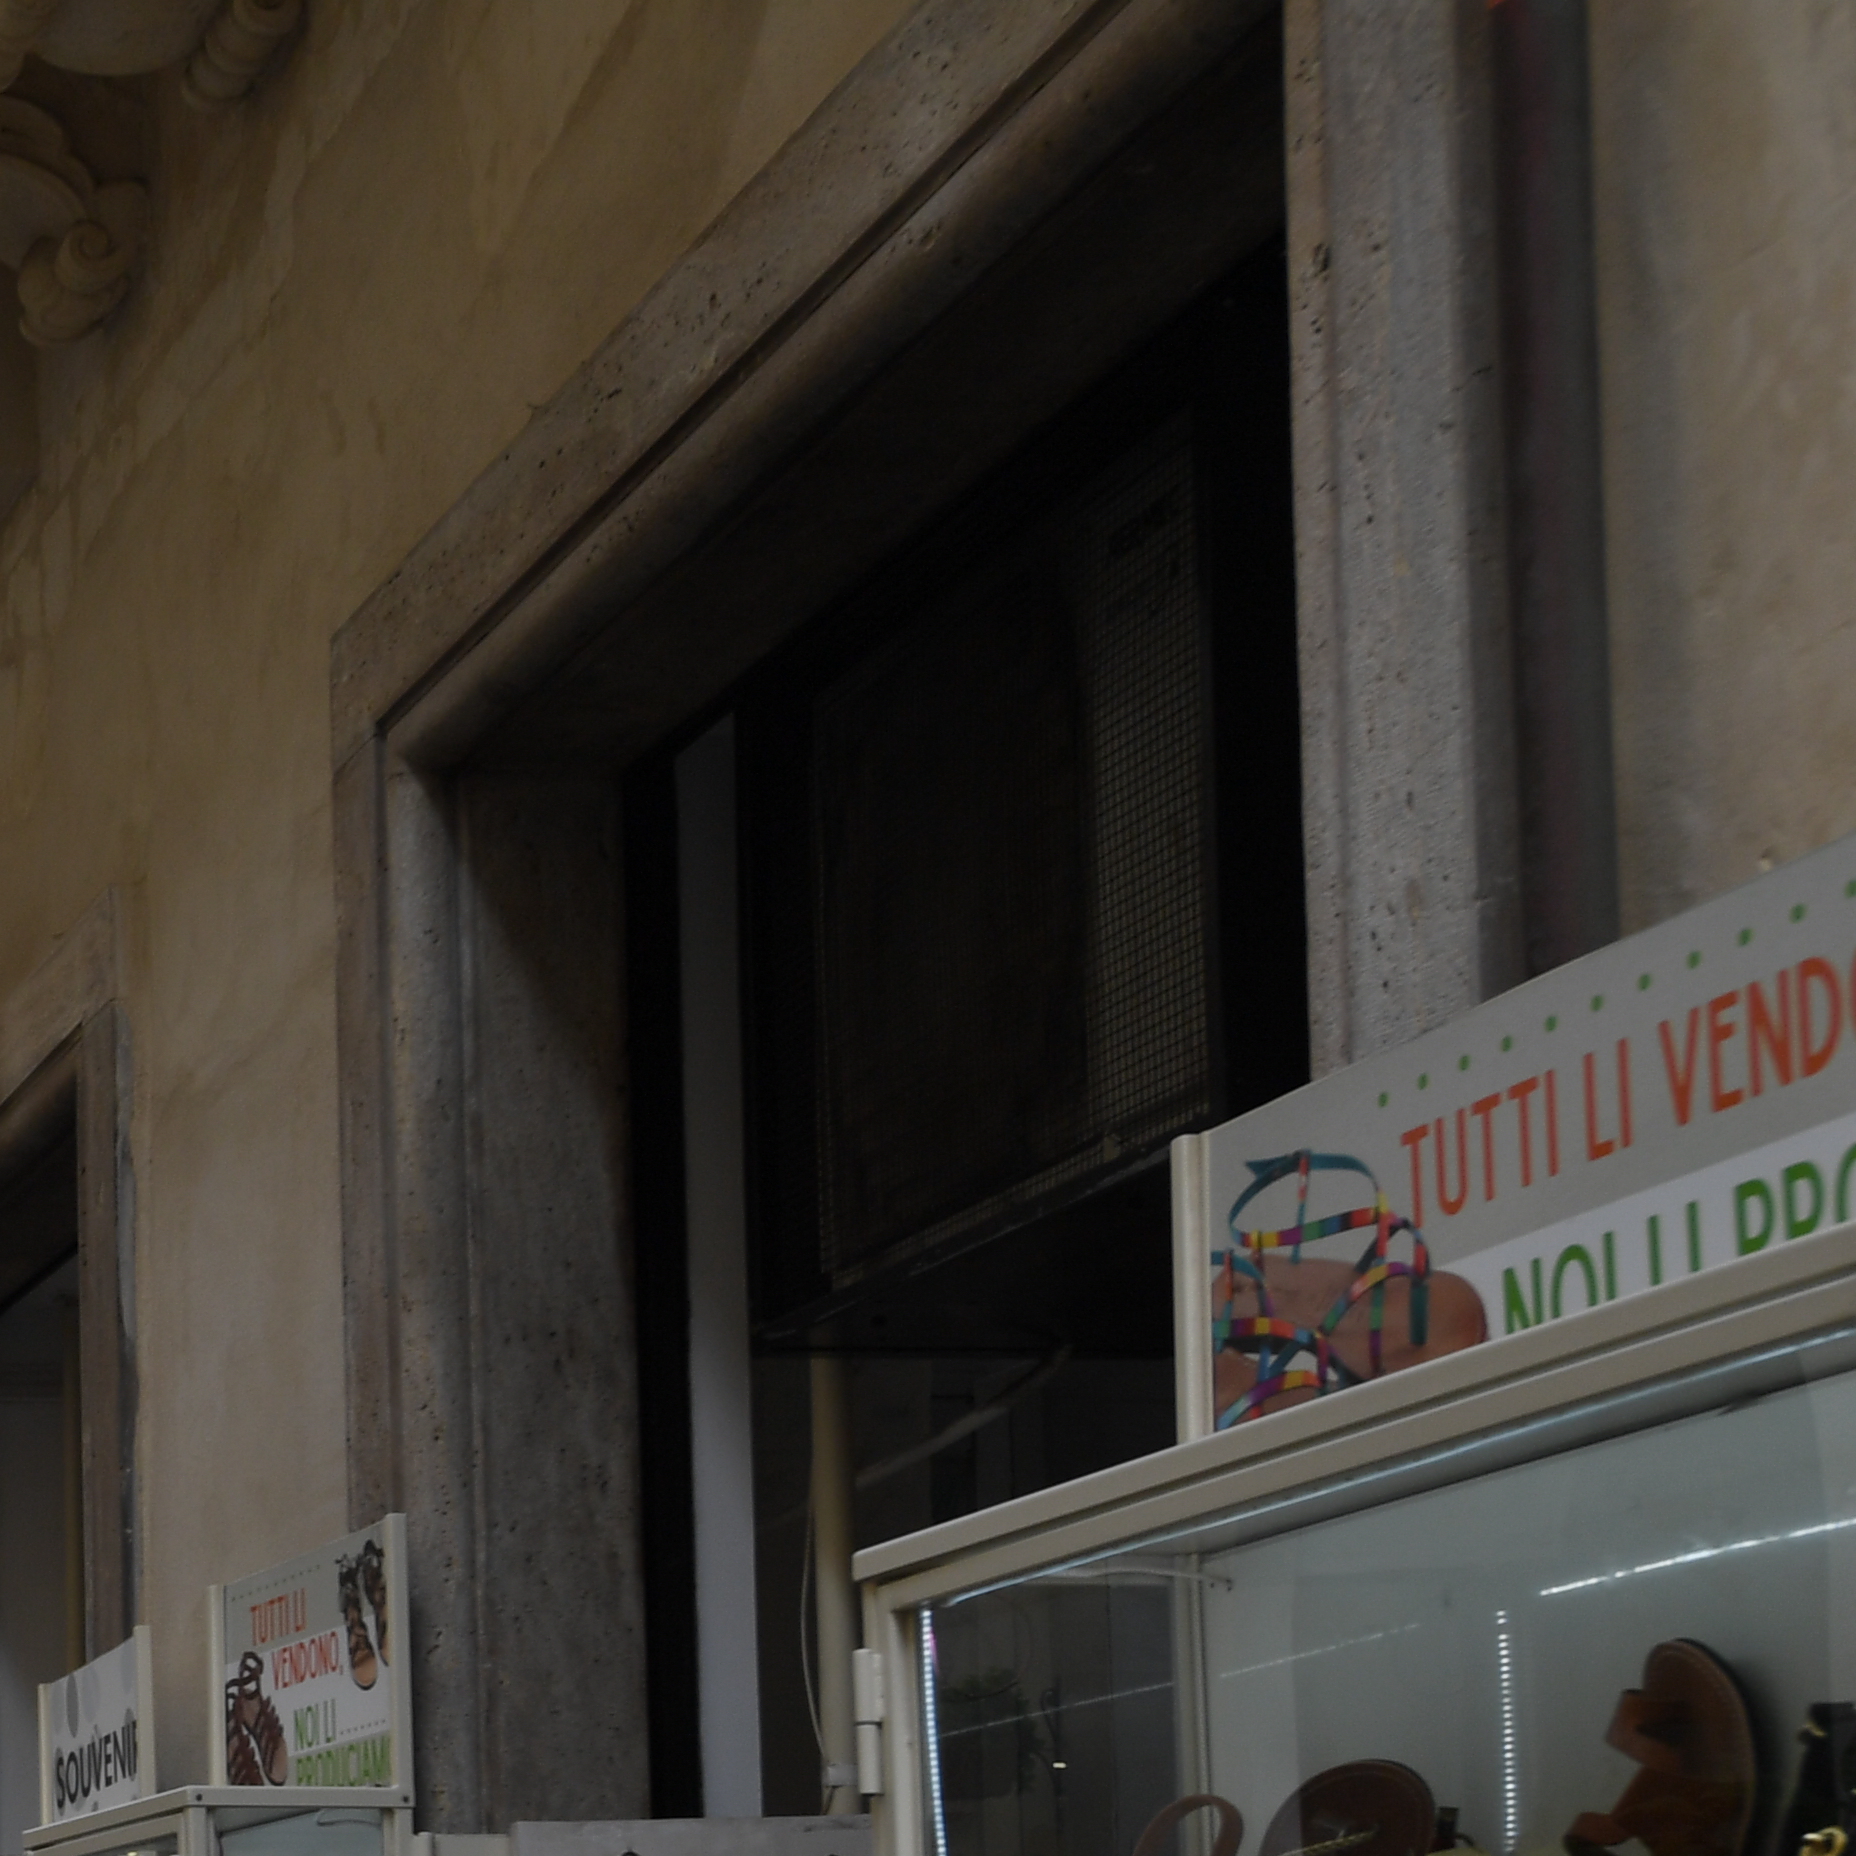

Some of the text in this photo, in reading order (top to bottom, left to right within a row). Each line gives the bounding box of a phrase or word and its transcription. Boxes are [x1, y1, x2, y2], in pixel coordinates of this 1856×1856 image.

[1400, 1070, 1559, 1230] TUTTI
[1583, 1038, 1634, 1162] LI
[250, 1587, 307, 1646] TUTTI LI
[293, 1698, 337, 1752] NOI LI
